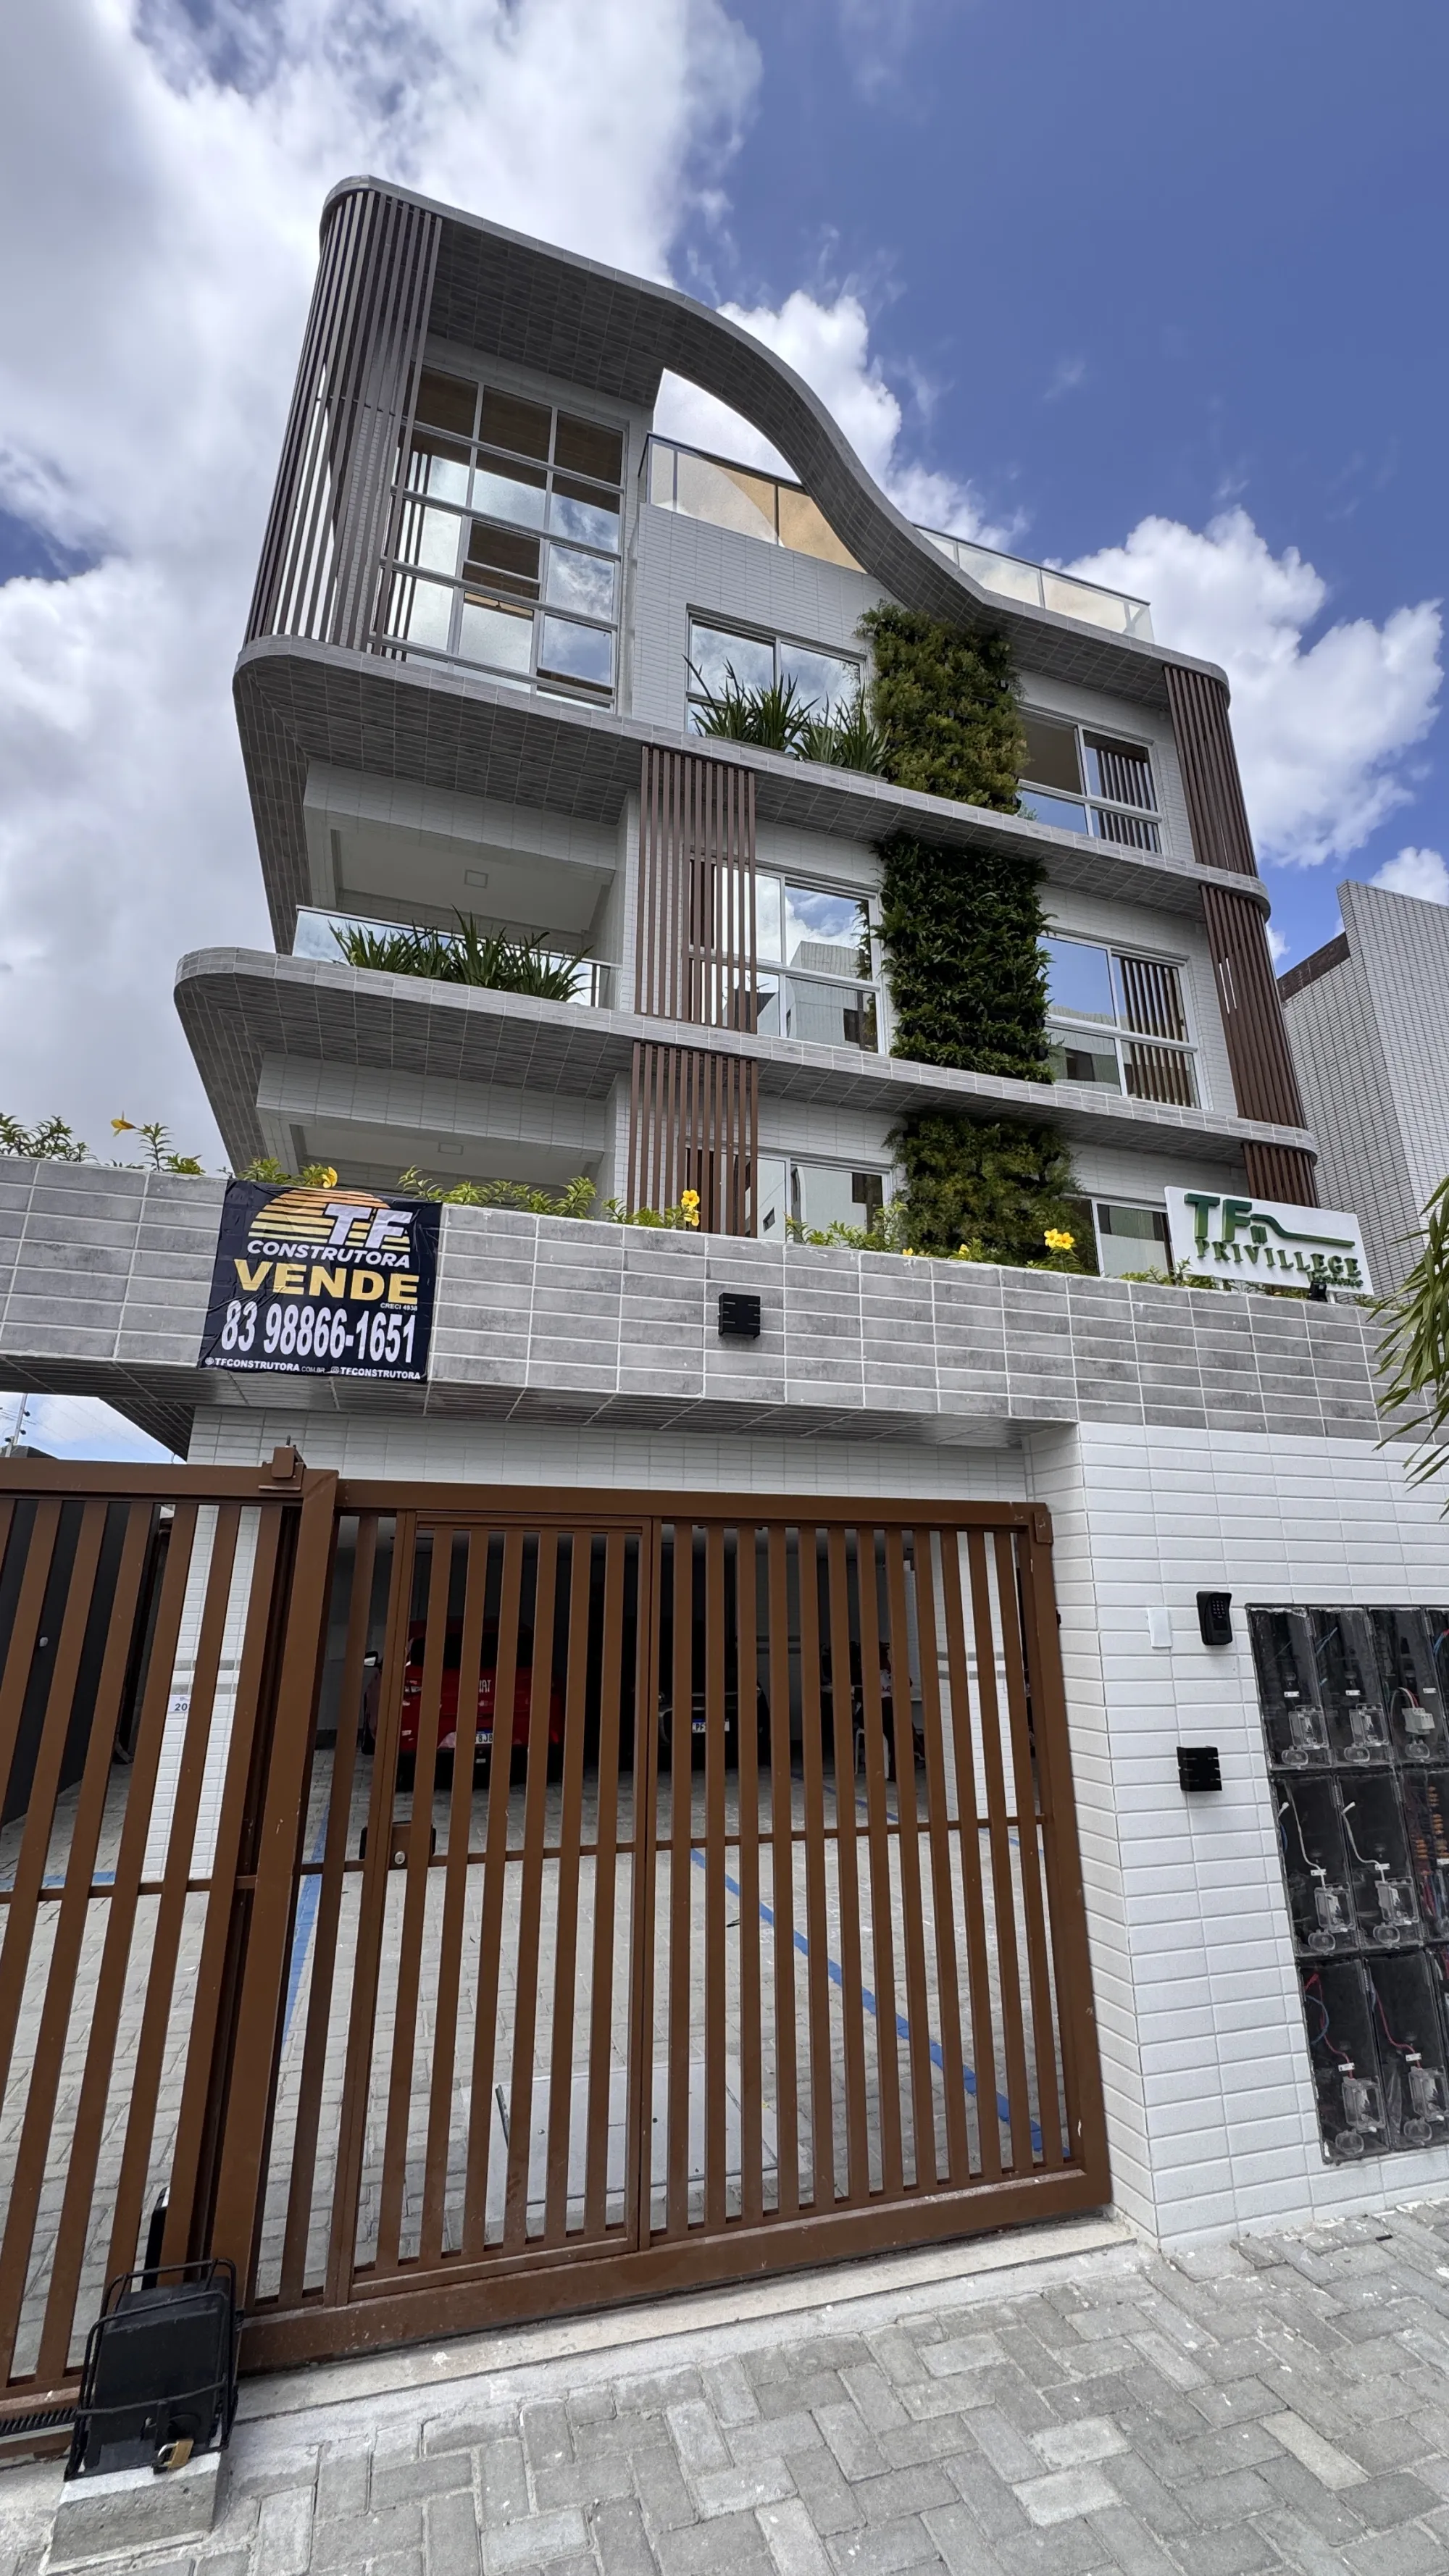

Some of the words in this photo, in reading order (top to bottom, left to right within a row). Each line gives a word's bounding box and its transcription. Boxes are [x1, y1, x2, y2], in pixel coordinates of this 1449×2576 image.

[325, 1203, 412, 1249] TF
[1185, 1194, 1252, 1242] TF
[247, 1241, 410, 1268] CONSTRUTORA
[1195, 1239, 1362, 1277] PRIVILLEGE
[234, 1259, 419, 1305] VENDE
[221, 1300, 258, 1351] 83
[263, 1303, 416, 1363] 98866-1651
[341, 1367, 420, 1379] TFCONSTRUTORA
[478, 1679, 491, 1693] IAT
